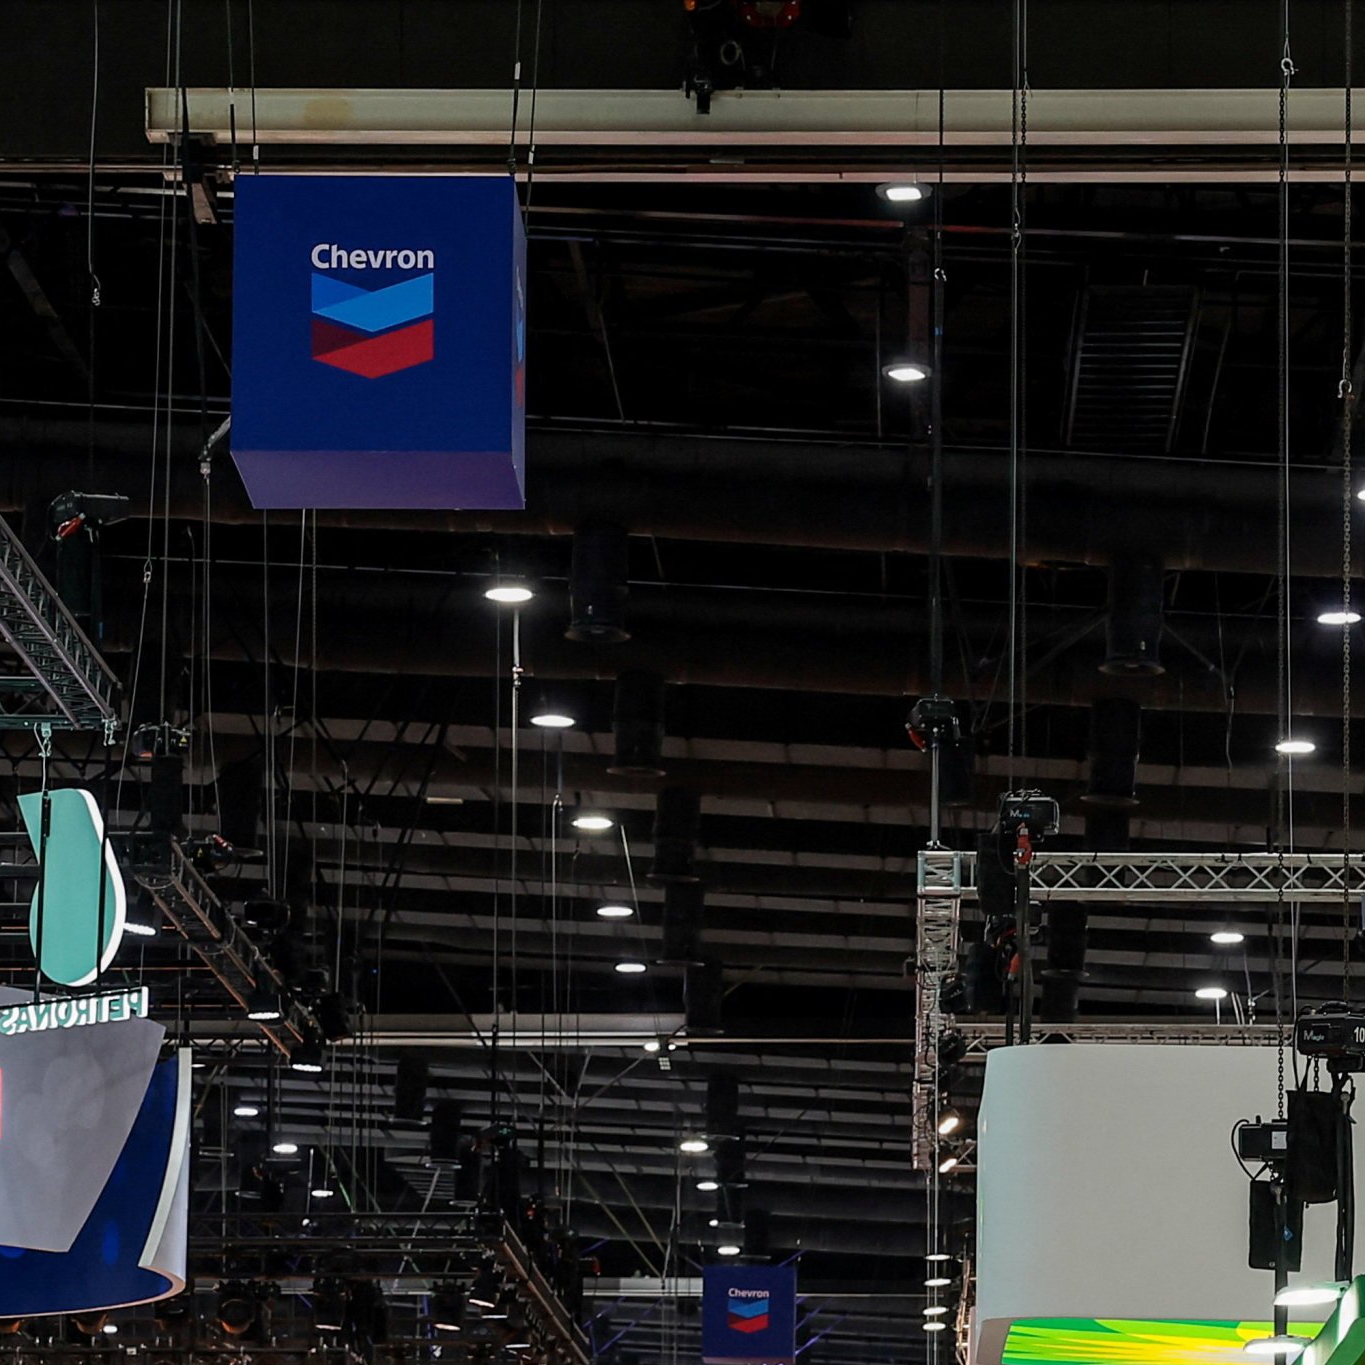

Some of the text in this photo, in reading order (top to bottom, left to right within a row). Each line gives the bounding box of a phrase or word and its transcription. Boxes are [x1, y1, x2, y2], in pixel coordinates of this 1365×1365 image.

[311, 244, 434, 269] Chevron
[1354, 1026, 1365, 1043] 10
[728, 1287, 770, 1298] Chevron
